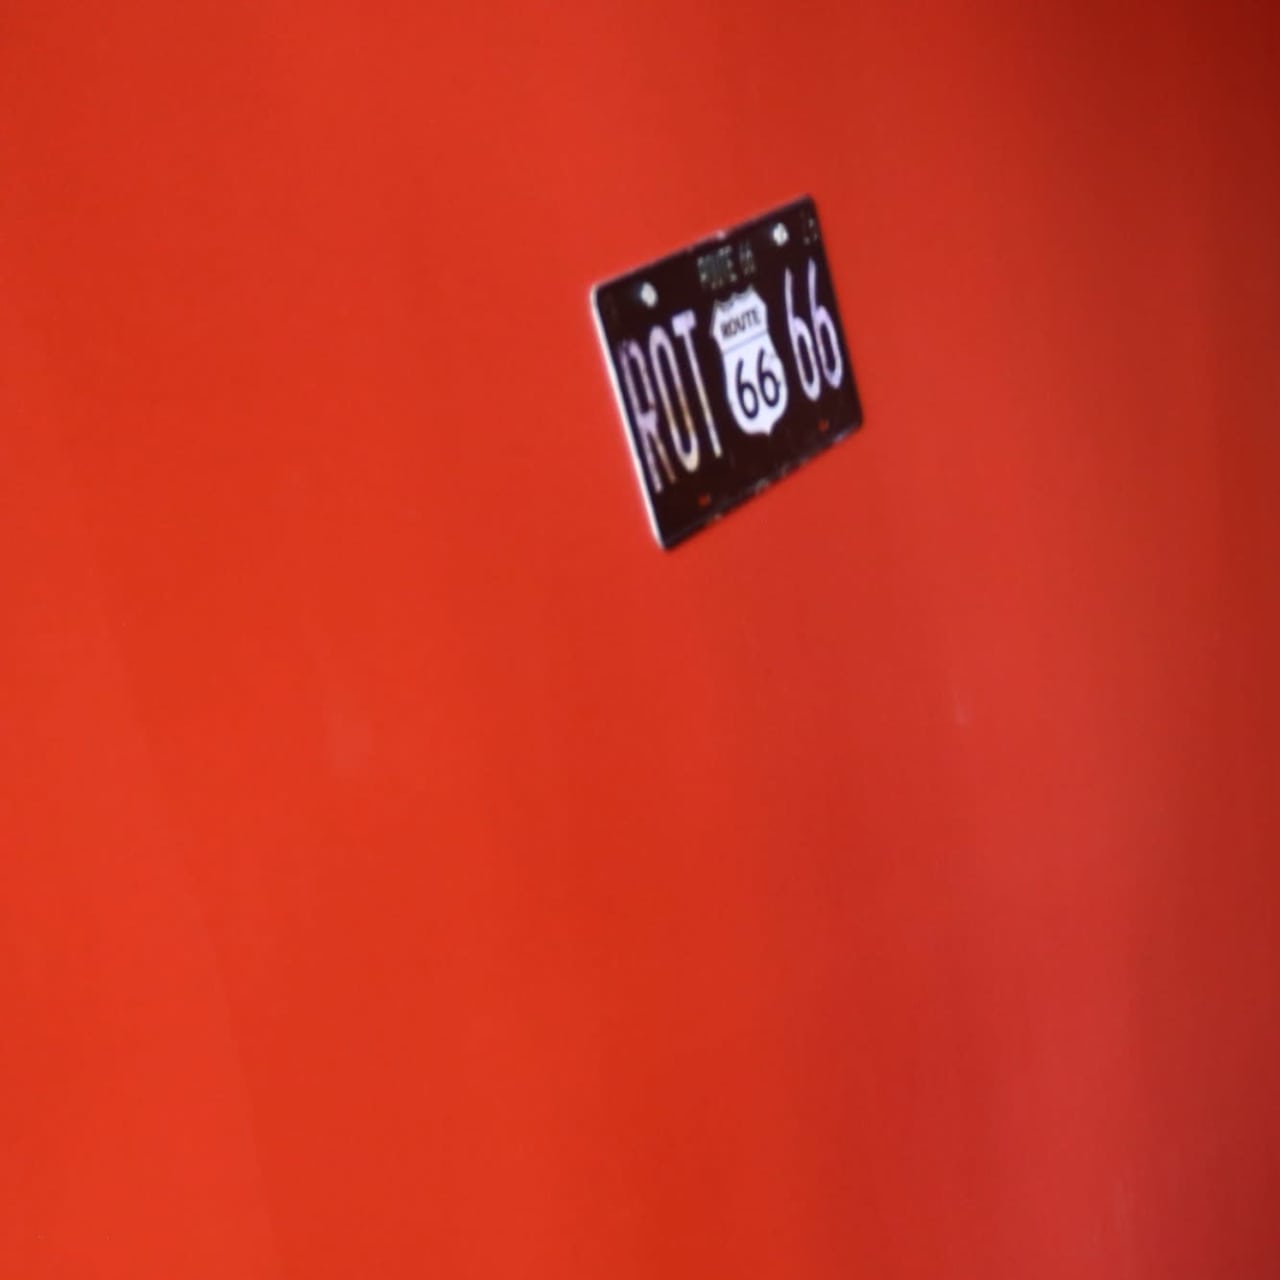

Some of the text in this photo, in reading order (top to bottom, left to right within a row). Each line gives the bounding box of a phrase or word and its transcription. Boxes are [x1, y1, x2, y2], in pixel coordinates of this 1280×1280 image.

[719, 307, 762, 341] ROUTE
[618, 257, 844, 494] ROT 66
[735, 346, 782, 420] 66
